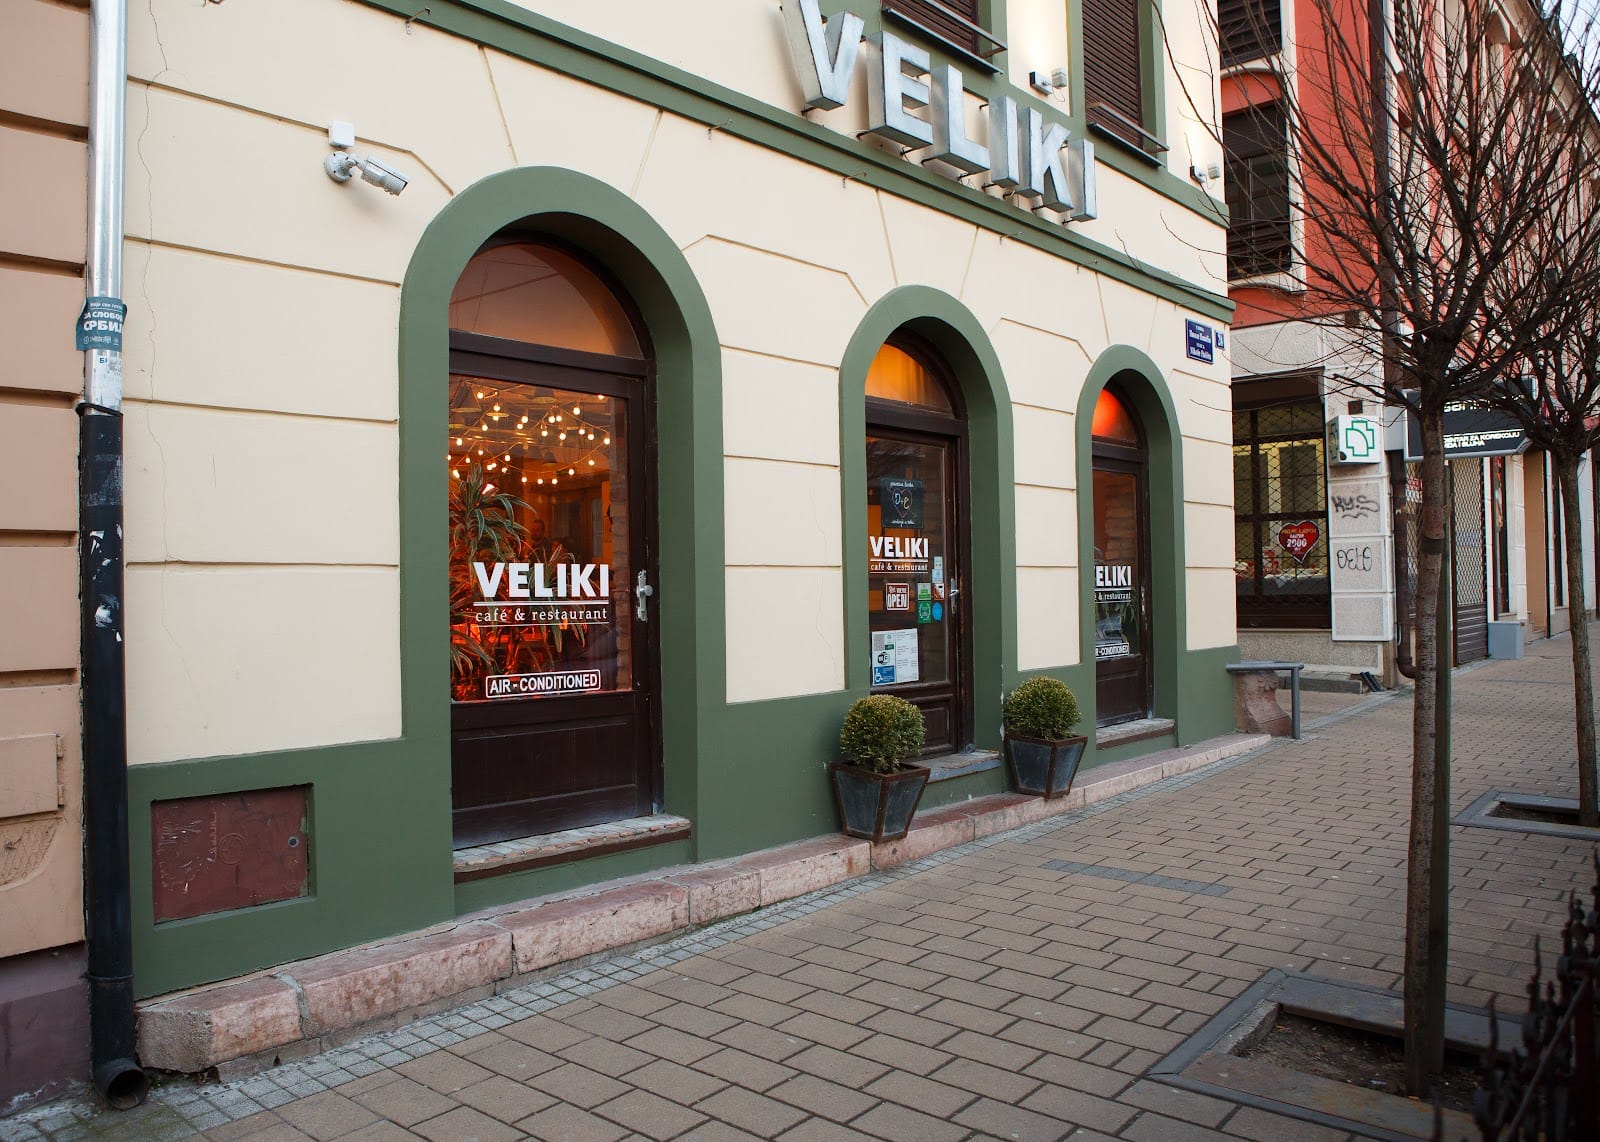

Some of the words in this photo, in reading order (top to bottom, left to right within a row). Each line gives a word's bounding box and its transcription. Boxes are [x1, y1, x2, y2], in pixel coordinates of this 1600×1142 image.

[781, 0, 1097, 222] VELIKI
[869, 536, 929, 558] VELIKI
[887, 562, 893, 571] &
[895, 563, 928, 571] restaurant
[473, 562, 609, 598] VELIKI
[1094, 566, 1131, 587] ELIKI
[887, 594, 907, 607] OPEN
[1104, 592, 1130, 600] restaurant
[475, 608, 507, 622] café
[515, 608, 526, 621] &
[532, 608, 608, 621] restaurant
